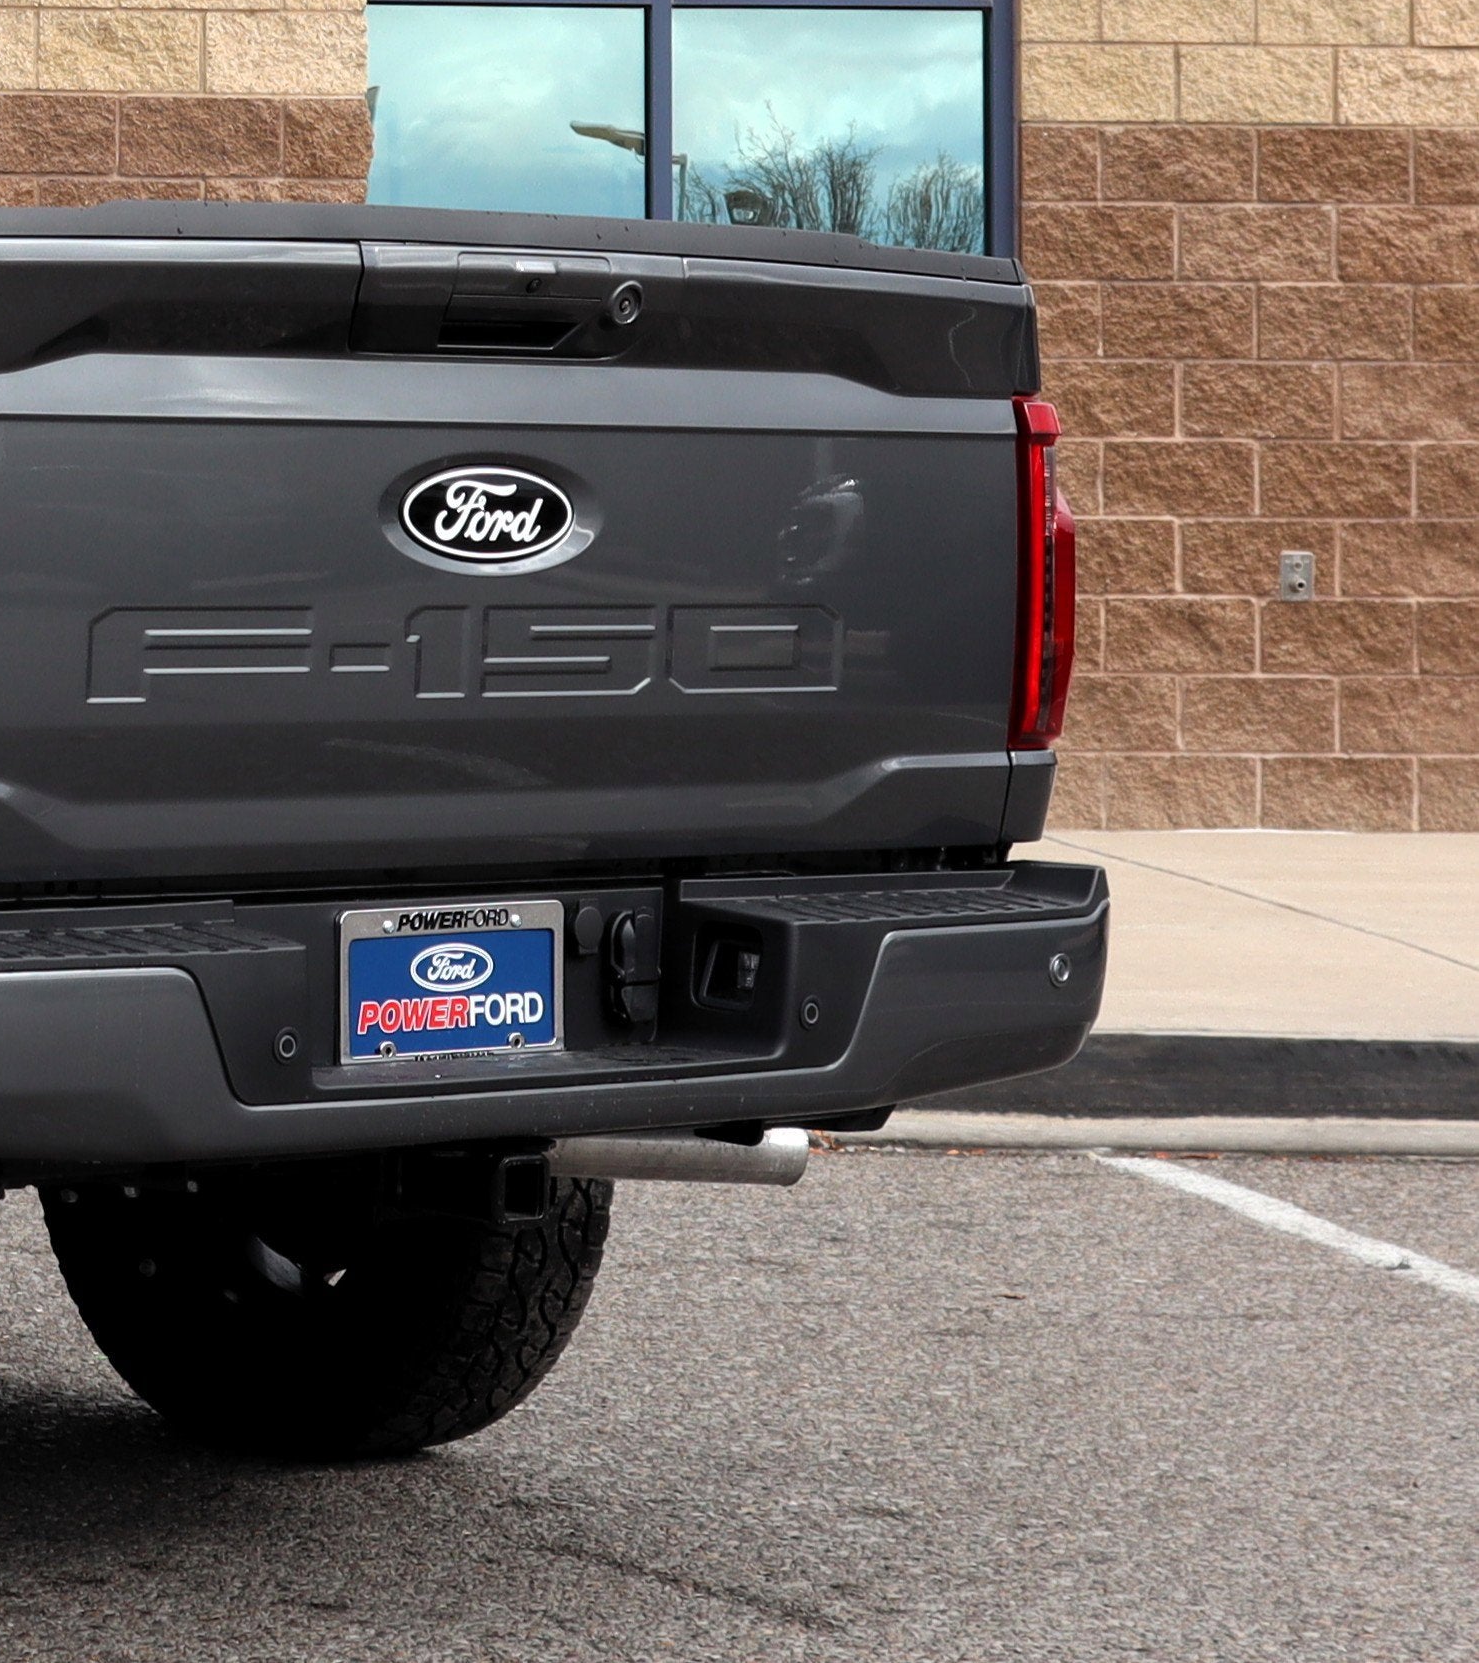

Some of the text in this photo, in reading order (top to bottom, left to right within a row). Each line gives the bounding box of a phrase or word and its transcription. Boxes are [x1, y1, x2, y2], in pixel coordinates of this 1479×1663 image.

[434, 479, 544, 545] Ford
[86, 604, 845, 704] F-150
[396, 908, 509, 933] POWERFORD
[426, 951, 477, 981] Ford
[356, 991, 544, 1035] POWERFORD
